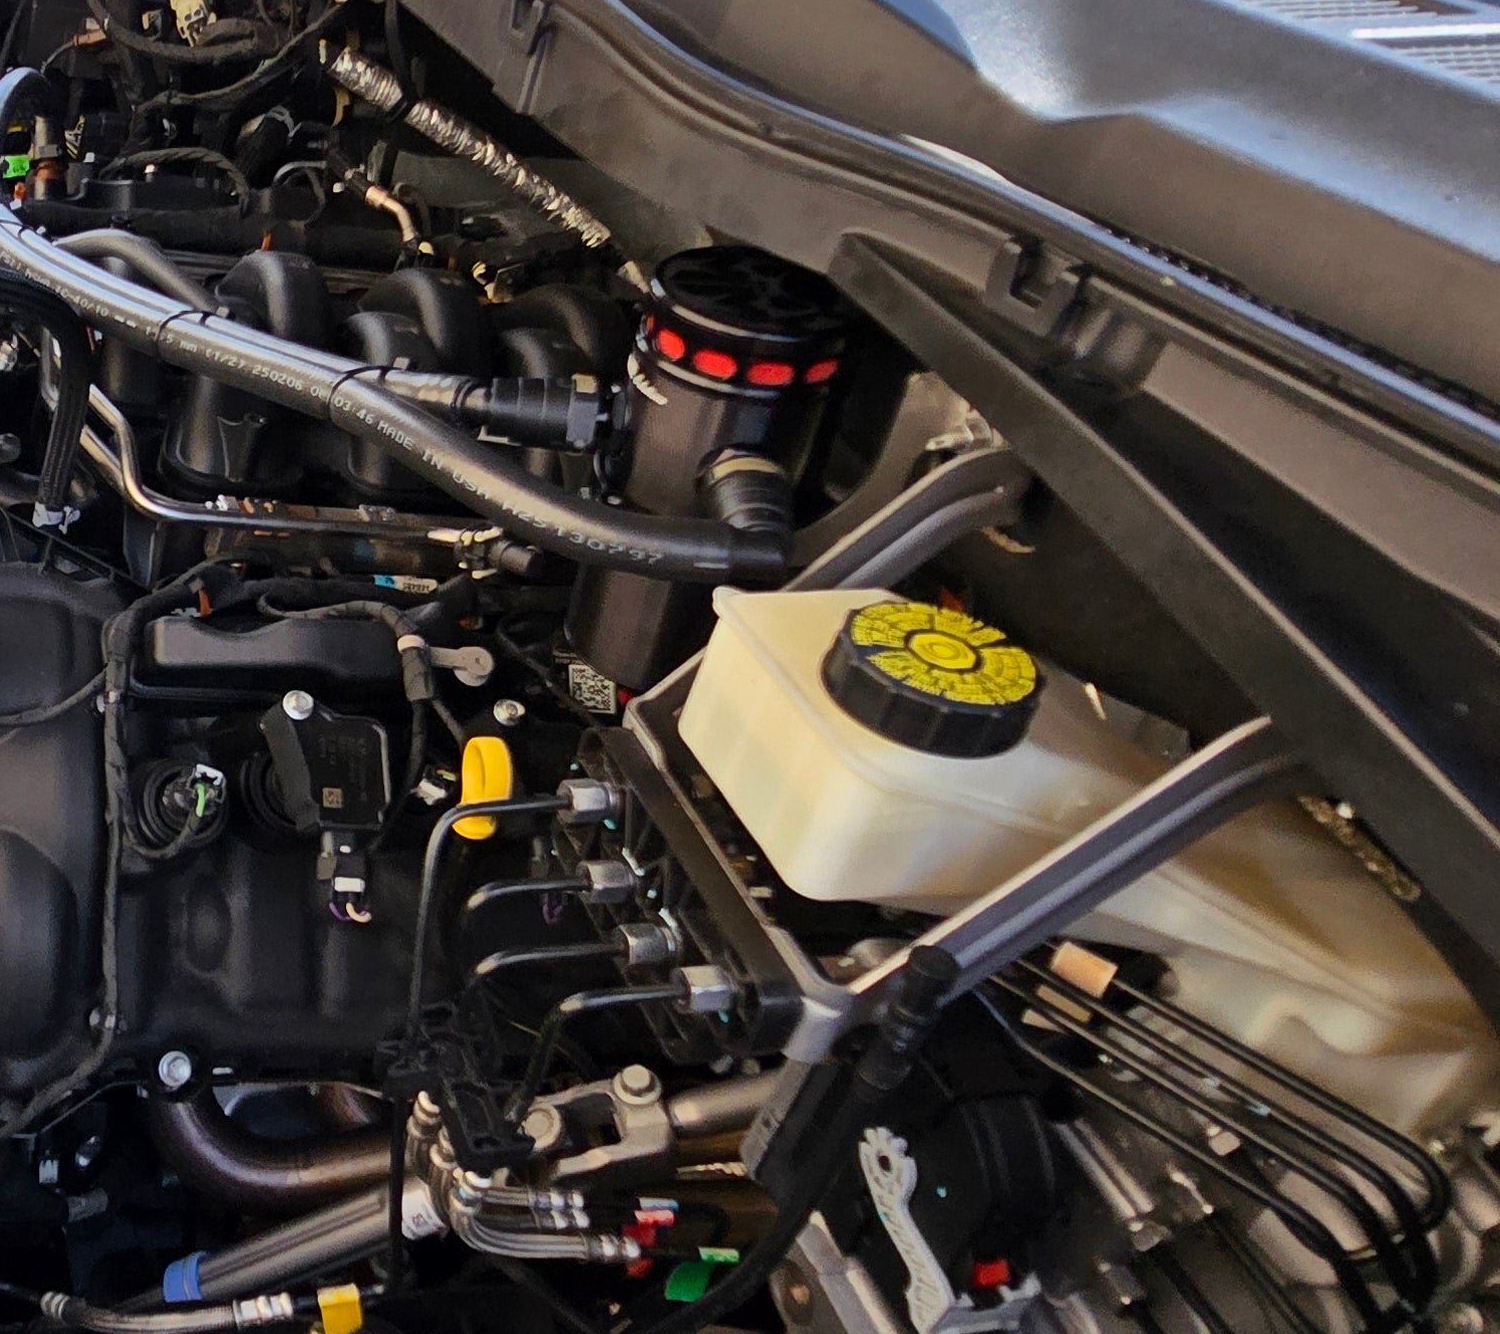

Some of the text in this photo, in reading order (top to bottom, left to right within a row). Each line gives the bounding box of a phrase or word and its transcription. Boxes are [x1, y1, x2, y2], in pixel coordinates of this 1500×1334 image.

[252, 365, 303, 391] 250206
[376, 418, 414, 451] MADE
[421, 451, 445, 471] IN
[451, 471, 491, 500] USA
